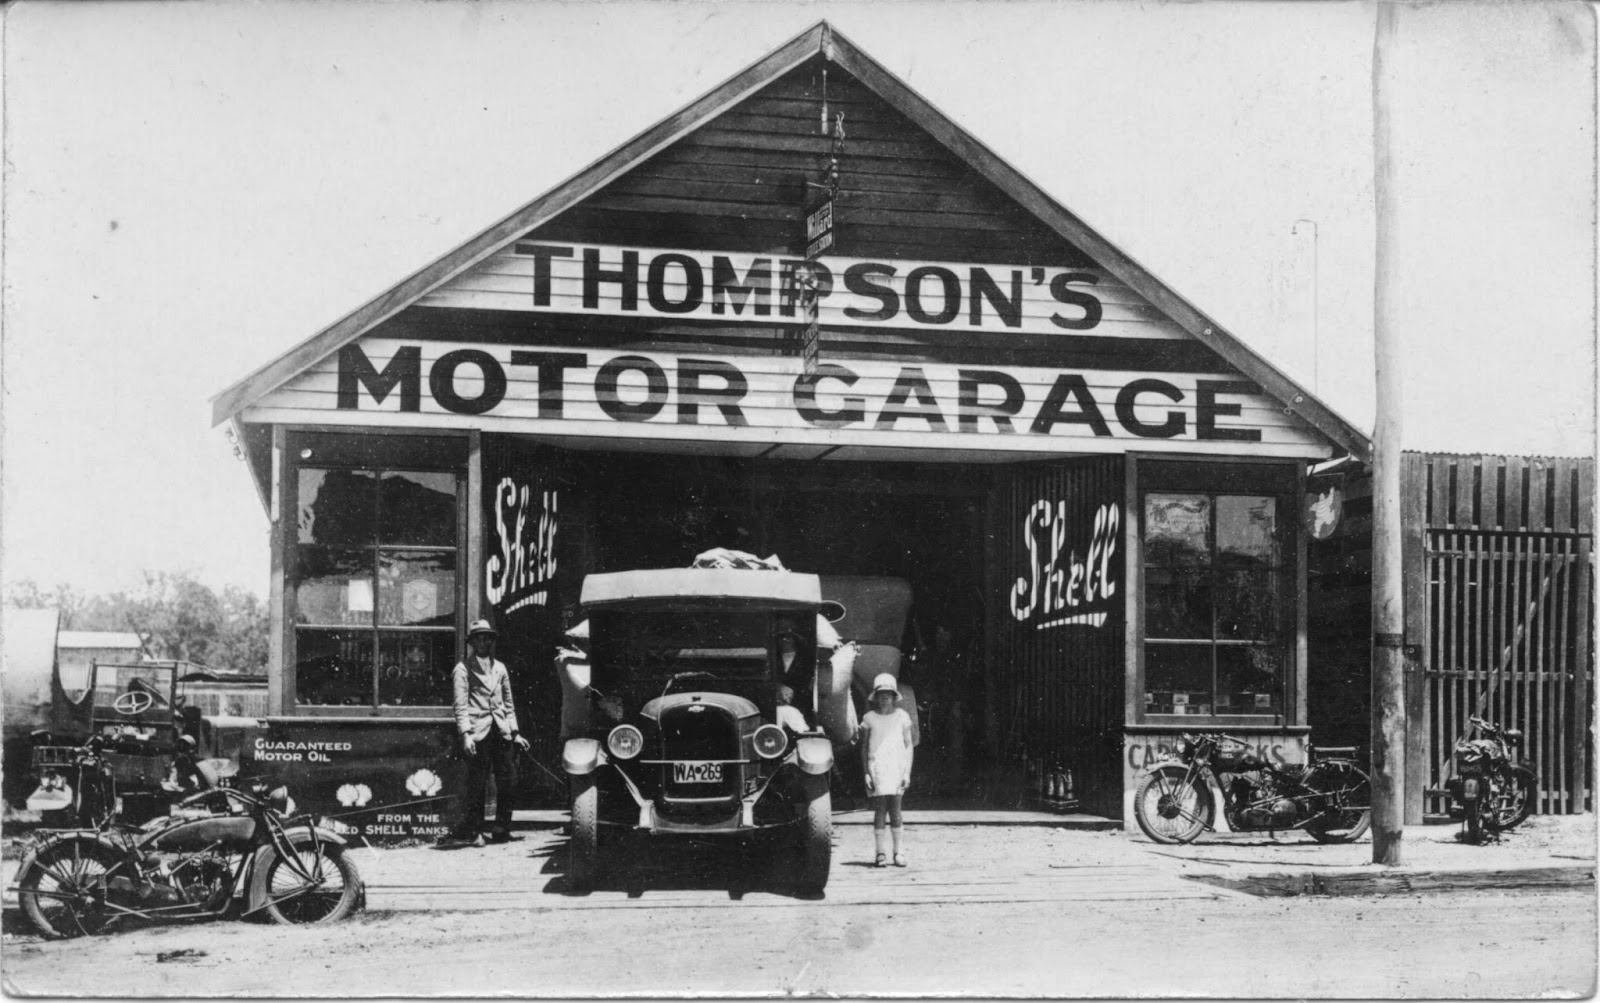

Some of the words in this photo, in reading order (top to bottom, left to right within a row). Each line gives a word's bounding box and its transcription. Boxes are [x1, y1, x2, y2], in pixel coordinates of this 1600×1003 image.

[514, 241, 1103, 331] THOMPSON'S
[337, 342, 750, 427] MOTOR
[792, 363, 1263, 443] GARAGE
[486, 476, 558, 605] Shell
[1010, 499, 1120, 621] Shell
[254, 737, 352, 751] GUARANTEED
[254, 749, 303, 762] MOTOR
[307, 750, 332, 763] OIL
[365, 824, 407, 835] SHELL
[377, 813, 412, 823] FROM
[416, 813, 440, 823] THE
